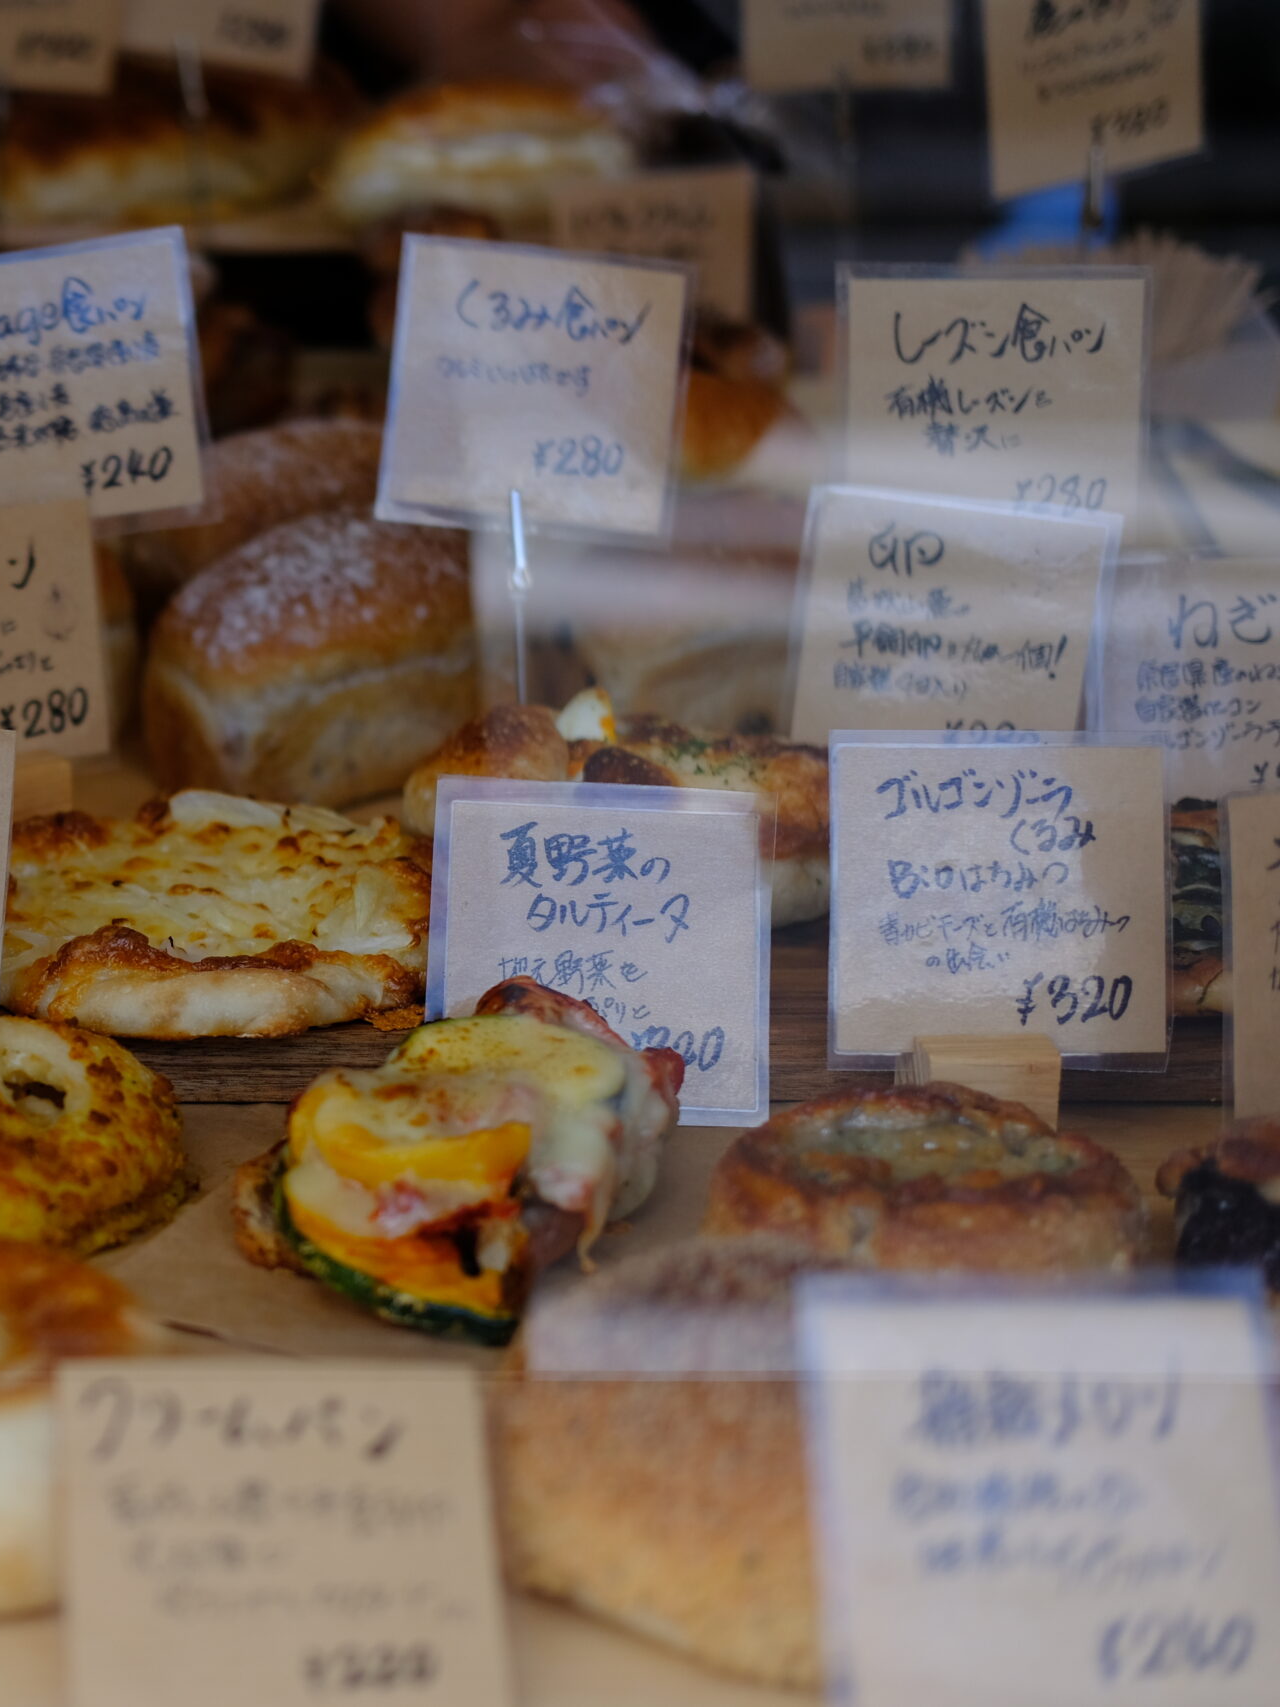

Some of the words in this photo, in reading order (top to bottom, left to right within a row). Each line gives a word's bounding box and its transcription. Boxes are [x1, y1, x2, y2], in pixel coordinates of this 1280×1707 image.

[456, 280, 652, 345] くるみ食パン
[894, 302, 1106, 365] レーズン食パン
[80, 445, 174, 496] ¥240
[532, 433, 624, 478] ¥280
[1168, 593, 1277, 650] ねぎ
[0, 686, 89, 738] ¥280
[876, 769, 1074, 820] ゴルゴンゾーラ
[499, 821, 671, 889] 夏野菜の
[1010, 815, 1097, 855] くるみ
[526, 893, 690, 944] タルティーヌ
[1016, 971, 1134, 1026] ¥320
